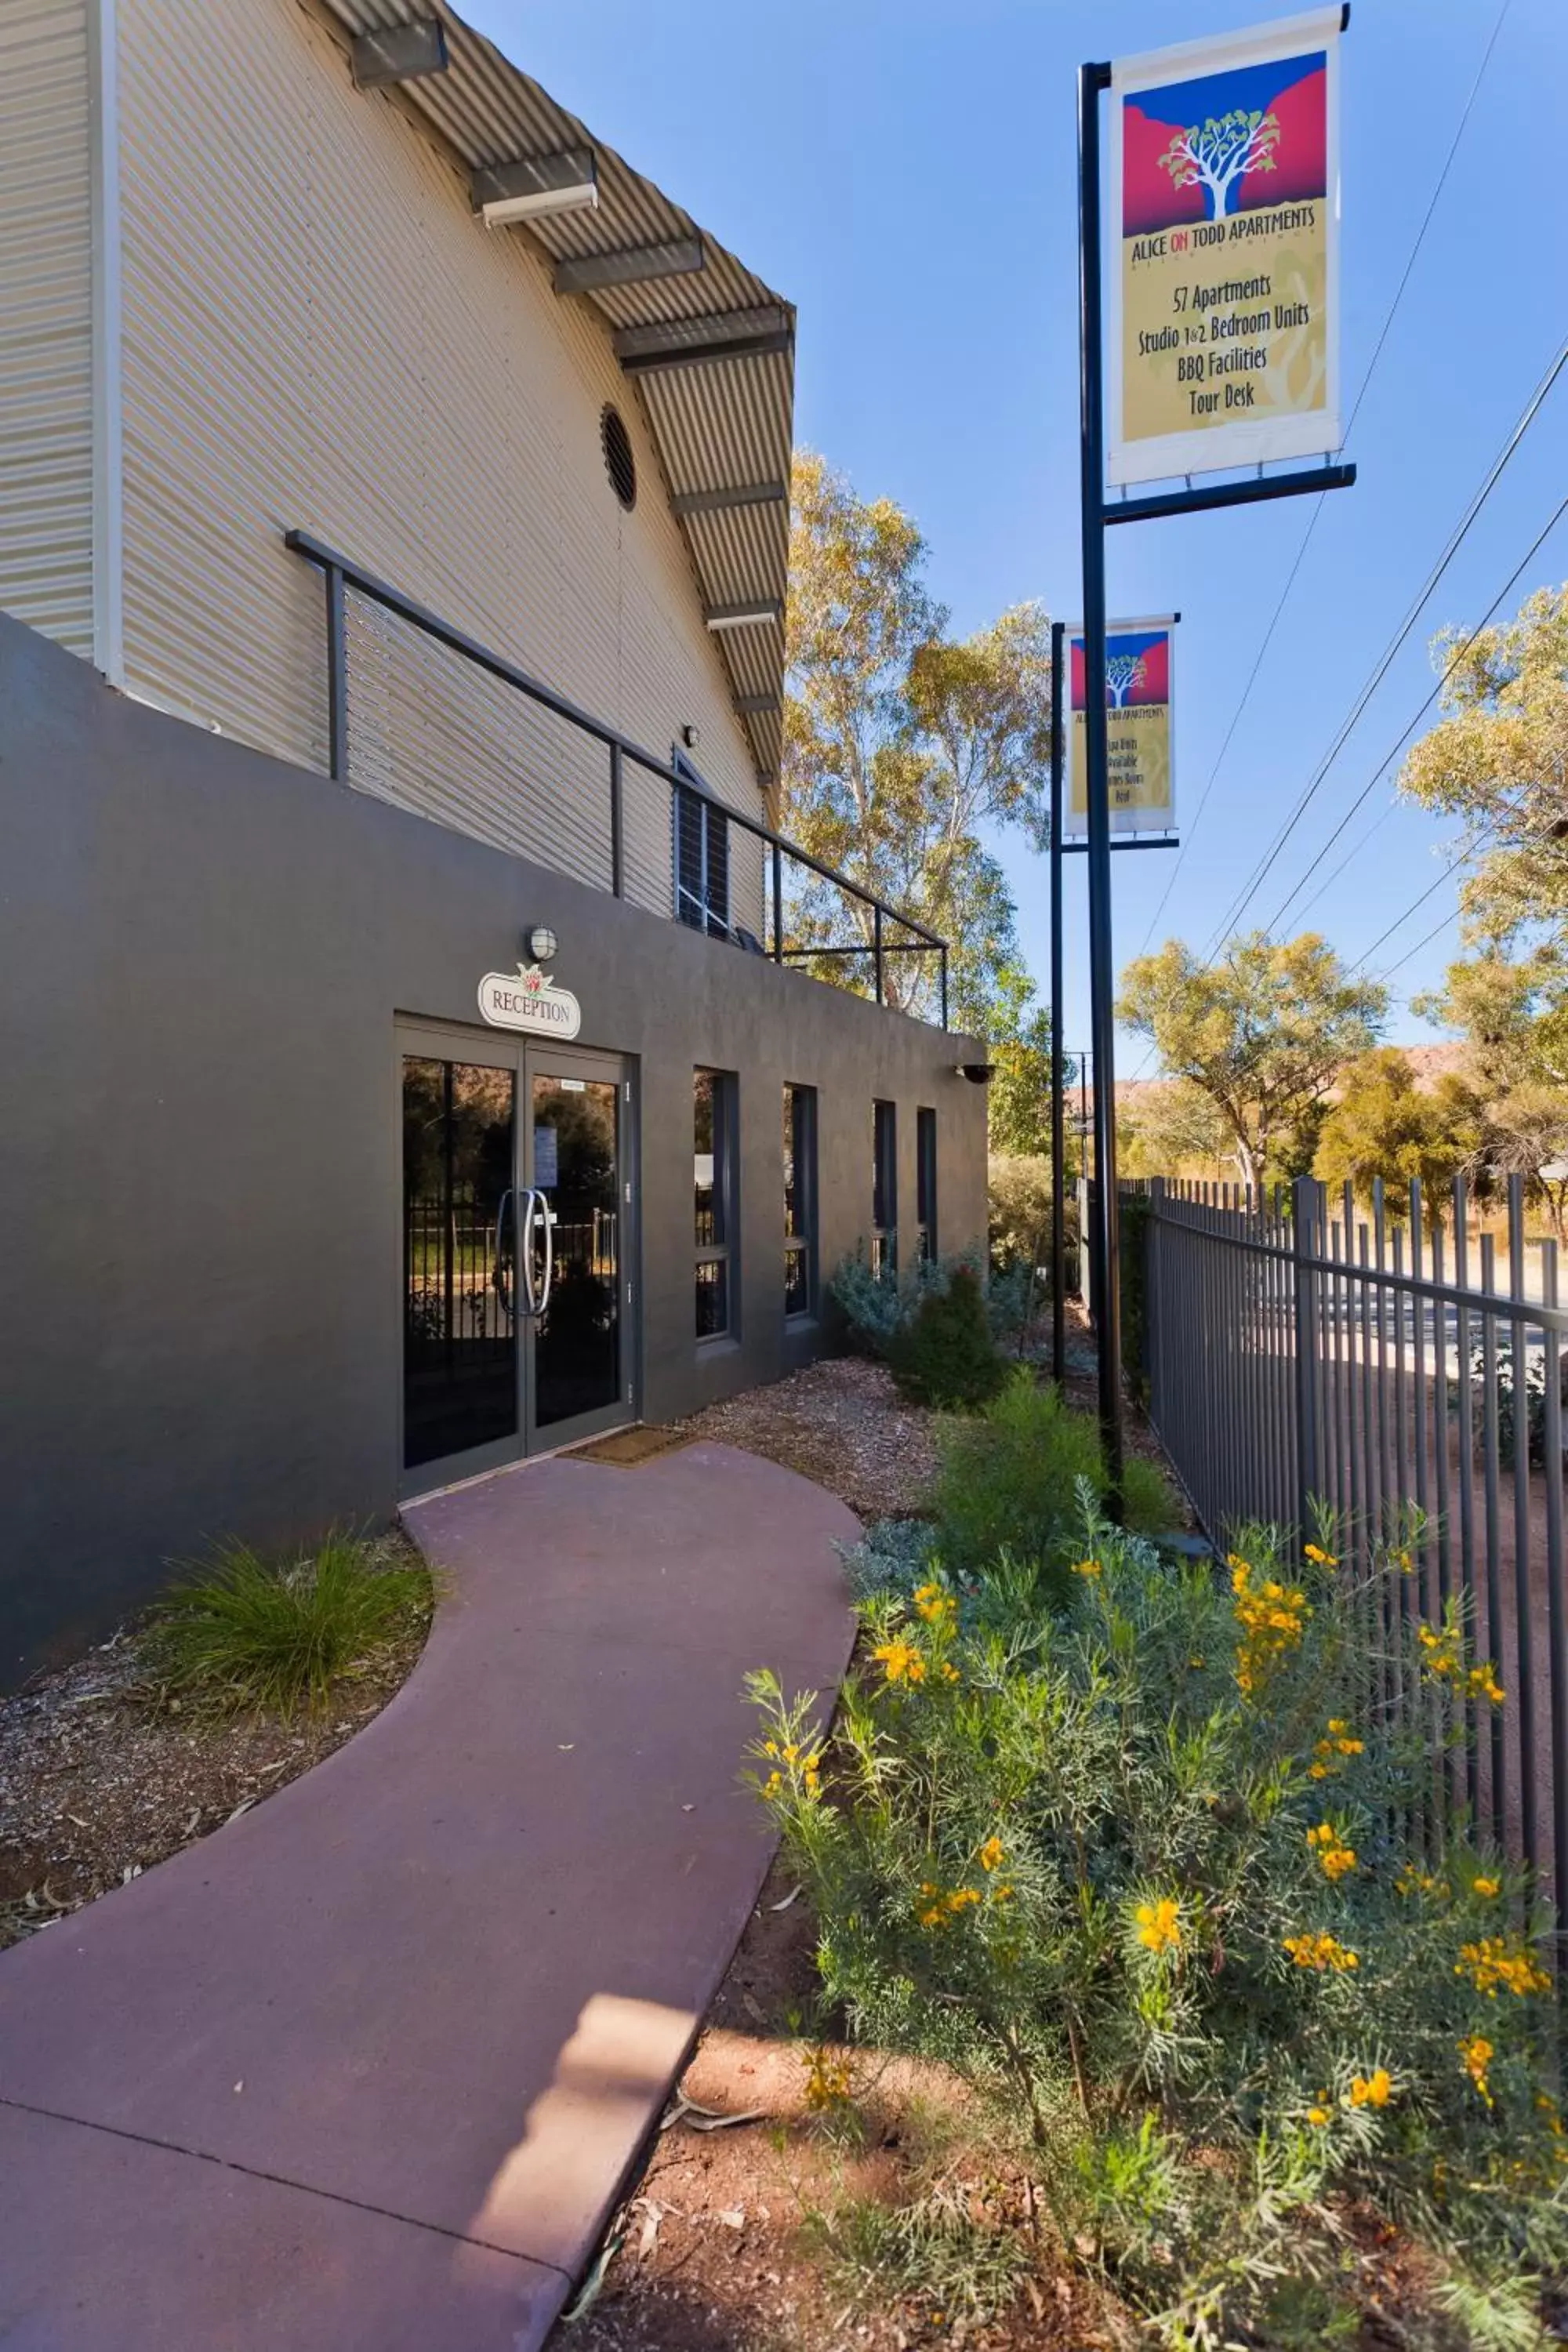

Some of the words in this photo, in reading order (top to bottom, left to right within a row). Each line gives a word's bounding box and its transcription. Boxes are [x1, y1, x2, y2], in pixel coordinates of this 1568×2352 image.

[1131, 236, 1167, 263] ALICE
[1171, 231, 1189, 252] ON
[1192, 223, 1226, 248] TODD
[1229, 205, 1316, 241] APARTMENTS
[1173, 286, 1189, 314] 57
[1192, 274, 1272, 313] Apartments
[1138, 325, 1180, 356] Studio
[1210, 310, 1271, 341] Bedroom
[1274, 302, 1309, 329] Units
[1178, 354, 1205, 382] BBQ
[1208, 346, 1267, 377] Facilities
[1189, 390, 1221, 415] Tour
[1225, 381, 1255, 408] Desk
[493, 990, 570, 1022] RECEPTION
